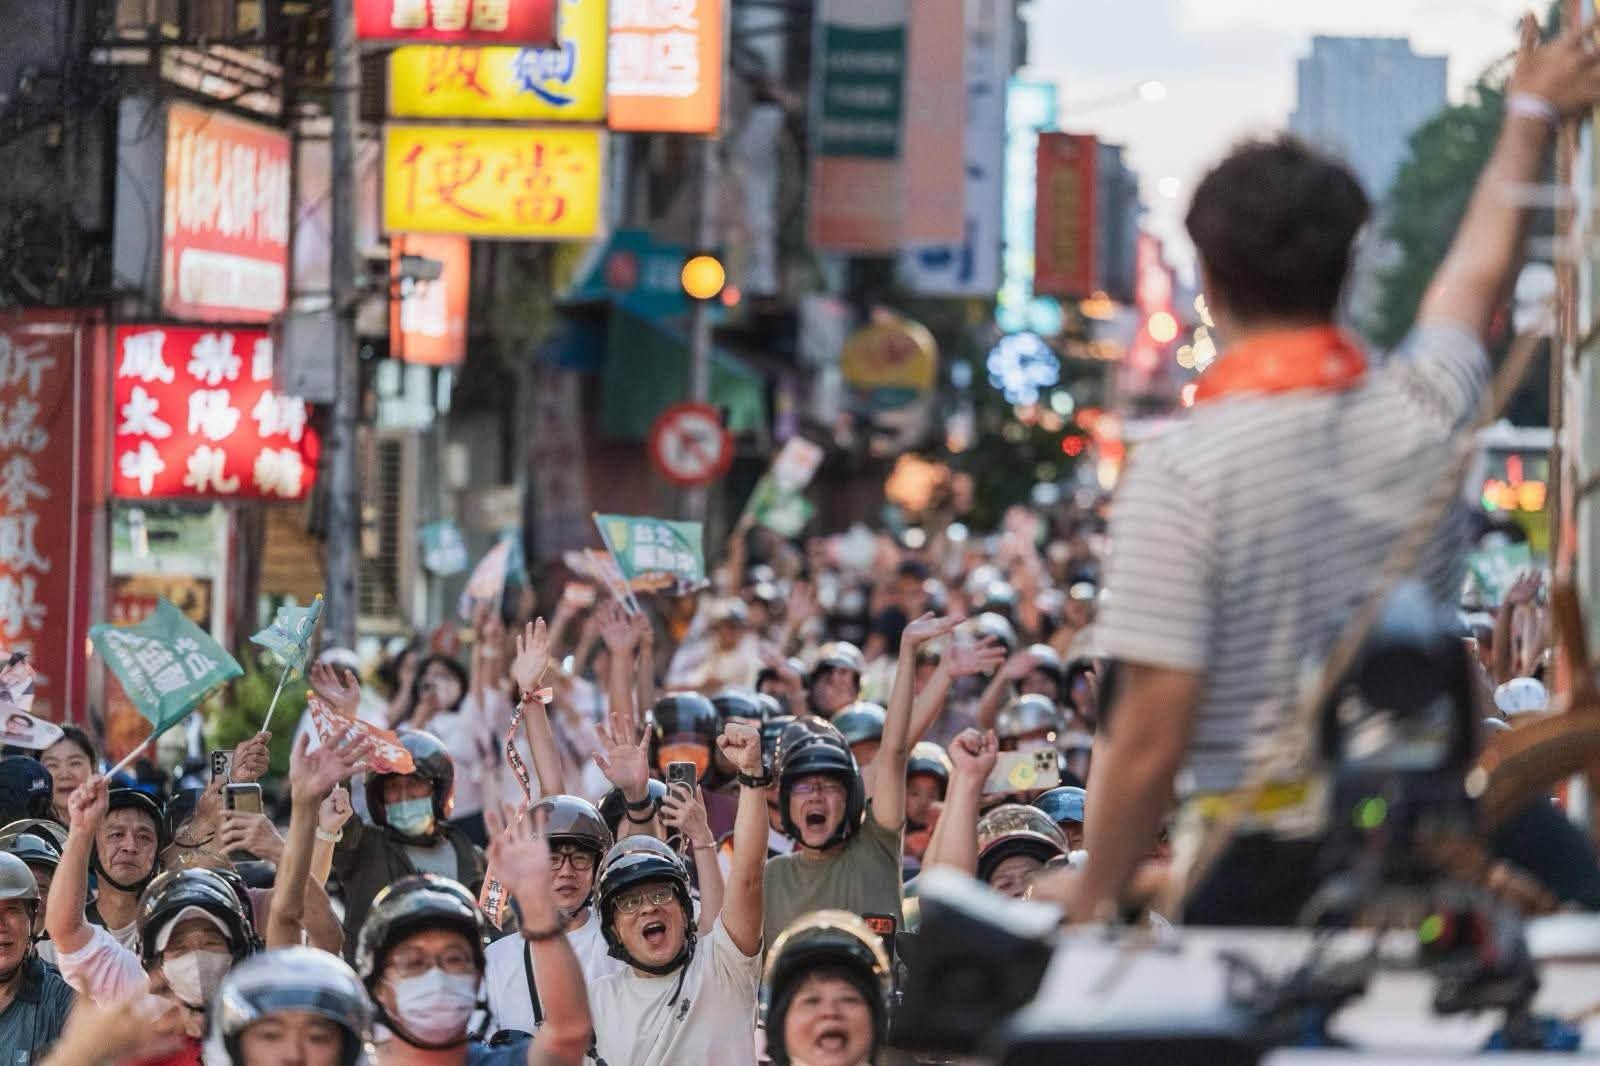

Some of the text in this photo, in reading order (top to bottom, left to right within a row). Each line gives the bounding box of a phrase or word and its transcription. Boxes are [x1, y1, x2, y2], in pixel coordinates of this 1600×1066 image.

[402, 140, 585, 224] 便當
[118, 385, 307, 443] 太陽餅
